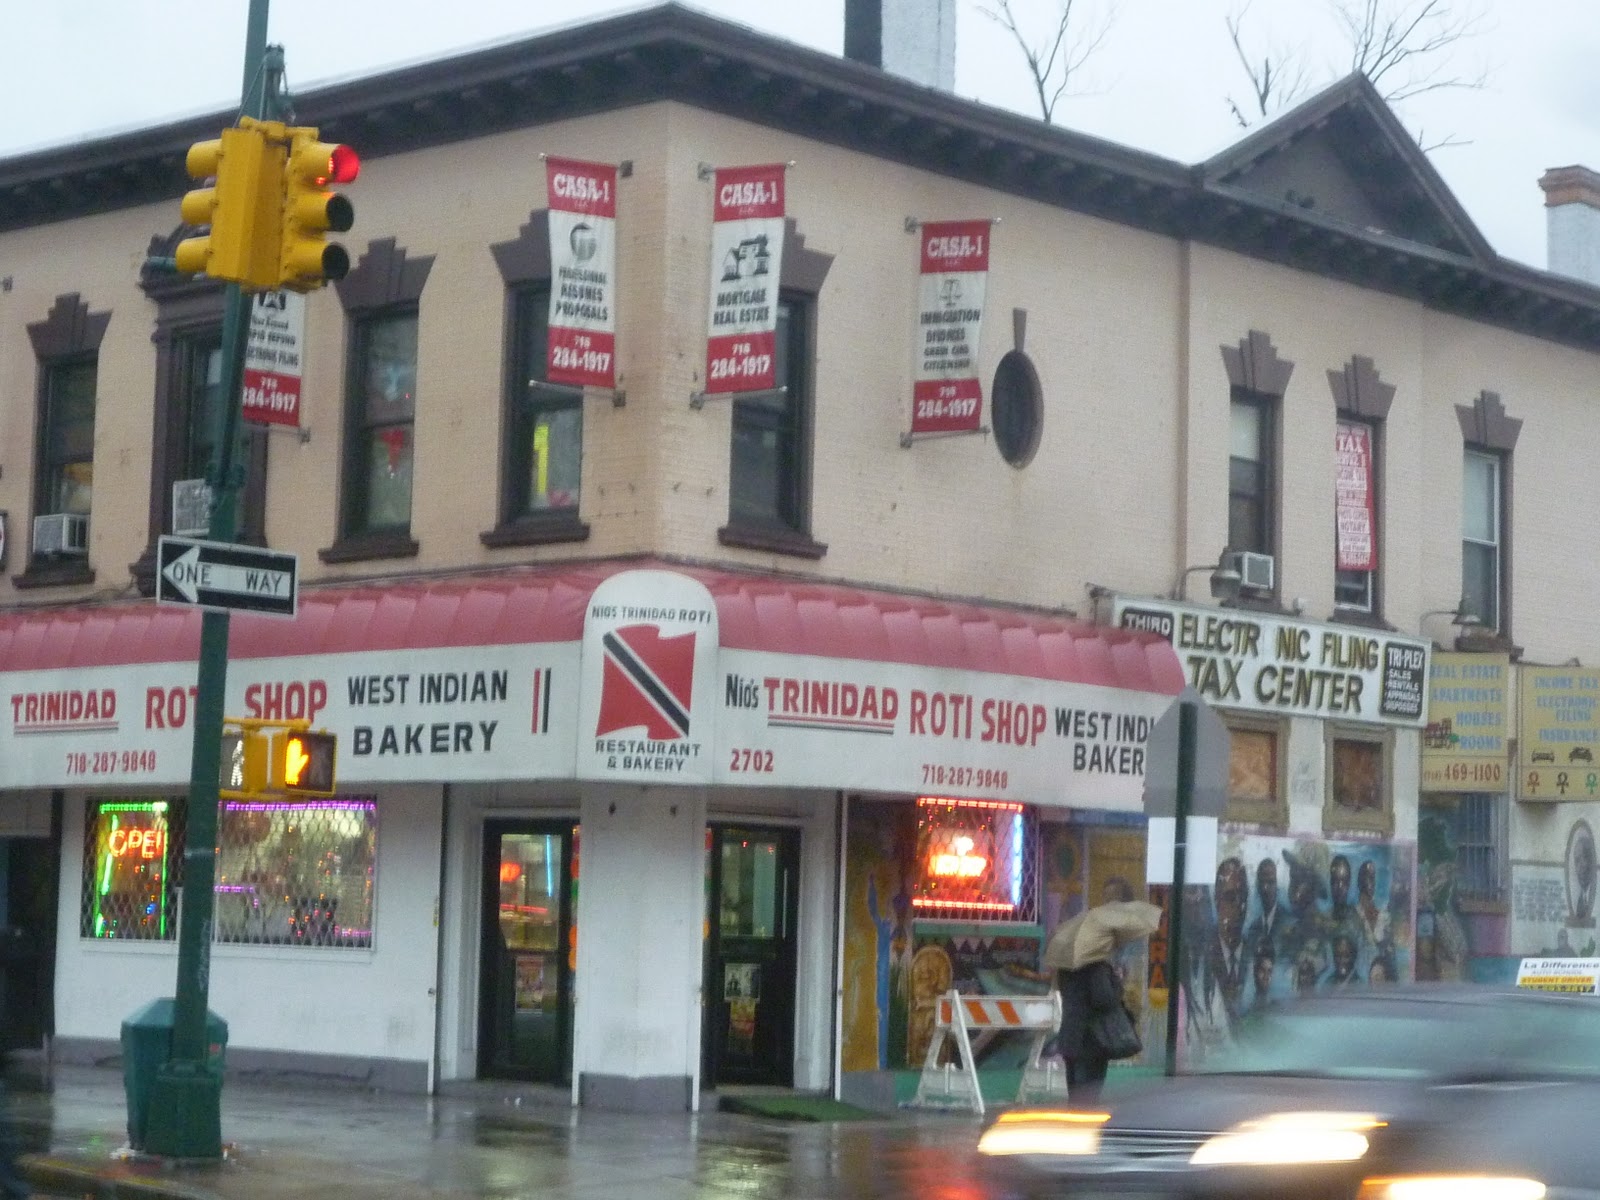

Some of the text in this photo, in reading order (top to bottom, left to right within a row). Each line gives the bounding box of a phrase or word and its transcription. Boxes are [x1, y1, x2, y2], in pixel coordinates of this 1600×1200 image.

[553, 172, 609, 203] CASA-1
[720, 181, 777, 206] CASA-1
[927, 235, 984, 258] CASA-1
[714, 309, 736, 326] REAL
[553, 345, 611, 373] 284-1917
[711, 354, 771, 380] 284-1917
[917, 398, 977, 418] 284-1917
[1337, 434, 1364, 452] TAX
[173, 562, 283, 594] ONE WAY
[621, 605, 675, 621] TRINIDAD
[678, 608, 711, 624] ROTI
[1125, 614, 1171, 634] THIRD
[1320, 632, 1379, 671] FILING
[1187, 655, 1365, 713] TAX CENTER
[11, 669, 508, 729] TRINIDAD RO SHOP WEST INDIAN
[763, 676, 899, 721] TRINIDAD
[909, 688, 973, 739] ROTI
[981, 699, 1047, 747] SHOP
[1055, 706, 1112, 738] WEST
[1116, 714, 1154, 743] IND
[352, 720, 499, 757] BAKERY
[595, 738, 701, 758] RESTAURANT
[607, 756, 685, 772] & BAKERY
[730, 748, 774, 772] 2702
[1073, 743, 1145, 776] BAKER
[1444, 763, 1501, 781] 469-1100
[1541, 961, 1600, 969] Difference
